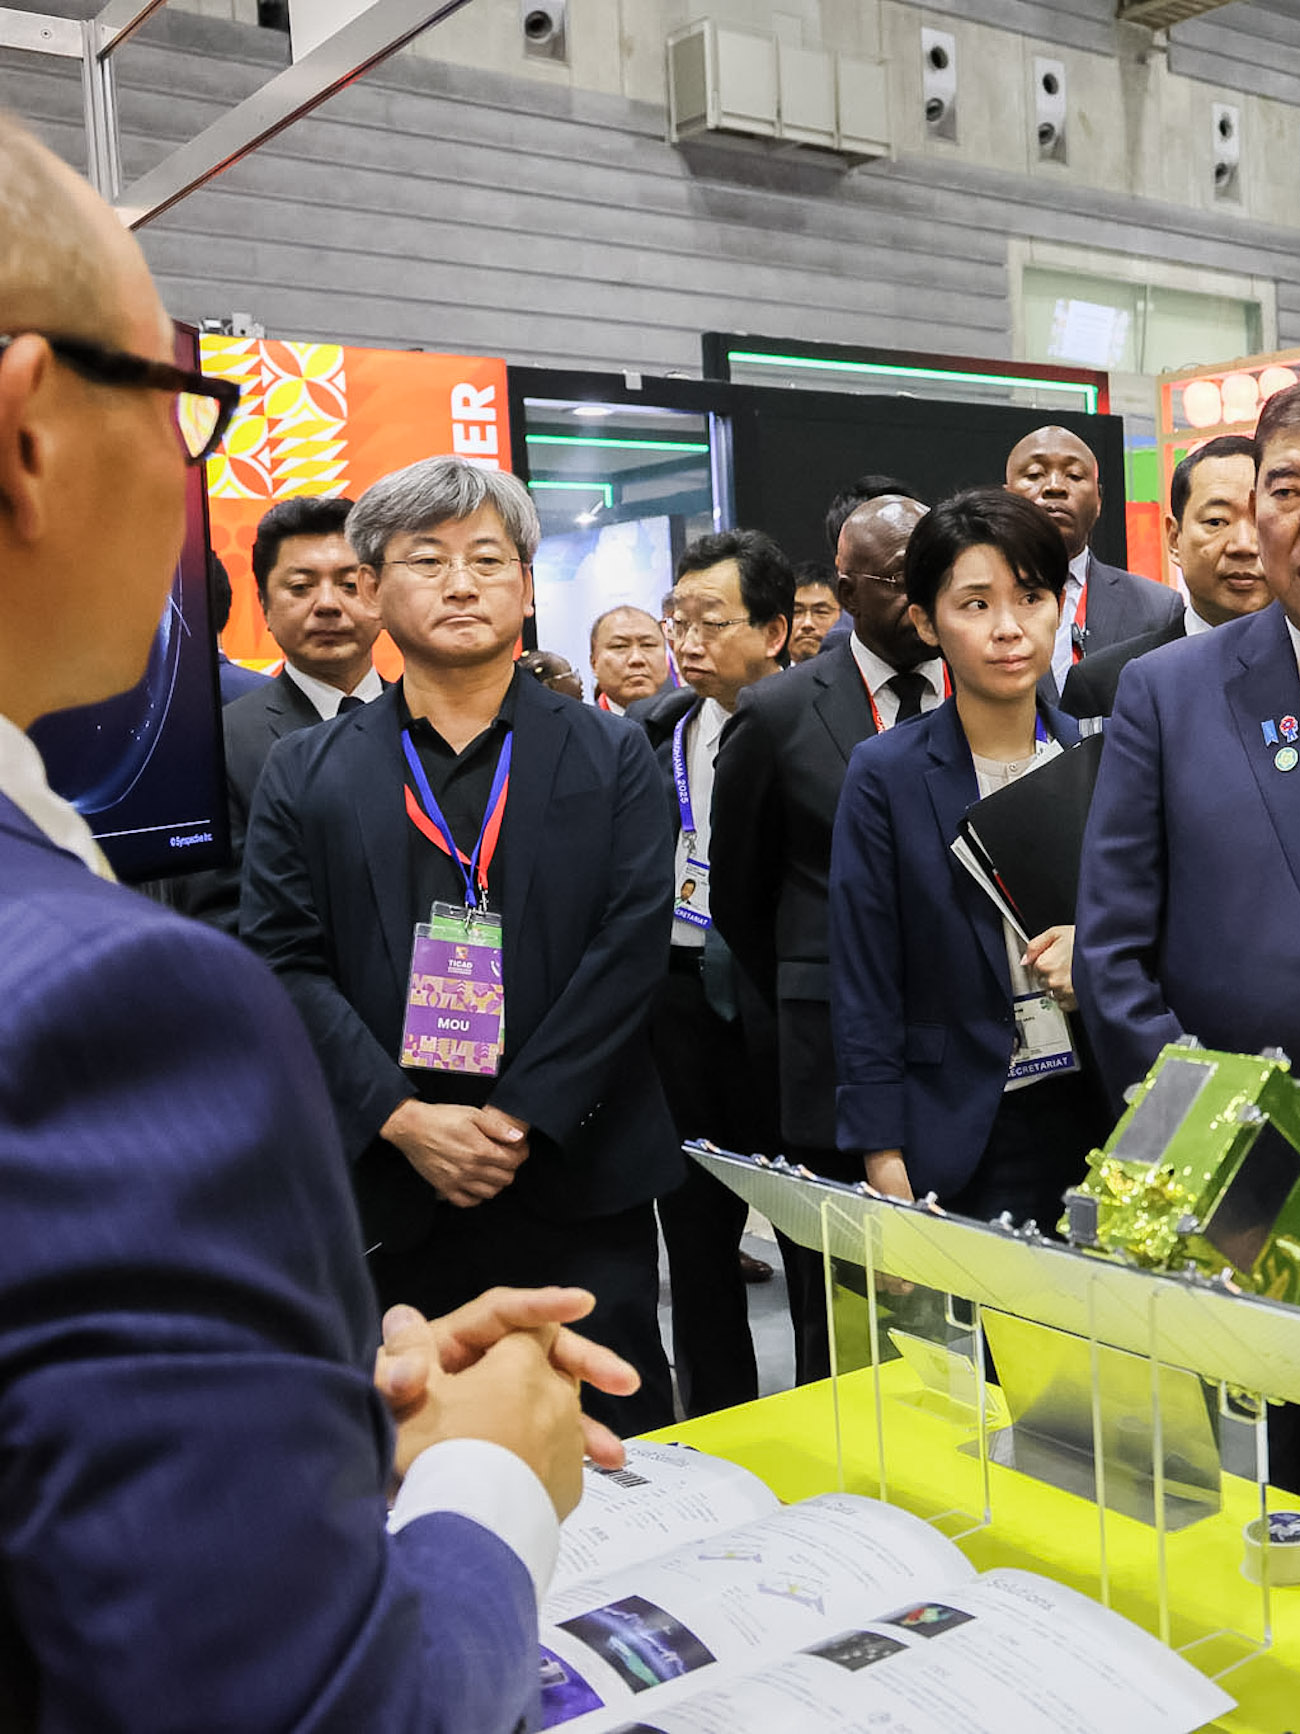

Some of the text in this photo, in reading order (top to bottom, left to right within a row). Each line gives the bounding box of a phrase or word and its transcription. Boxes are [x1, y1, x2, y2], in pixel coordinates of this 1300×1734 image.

[677, 779, 690, 805] 2025
[447, 958, 474, 969] TICAD
[437, 1017, 470, 1032] MOU
